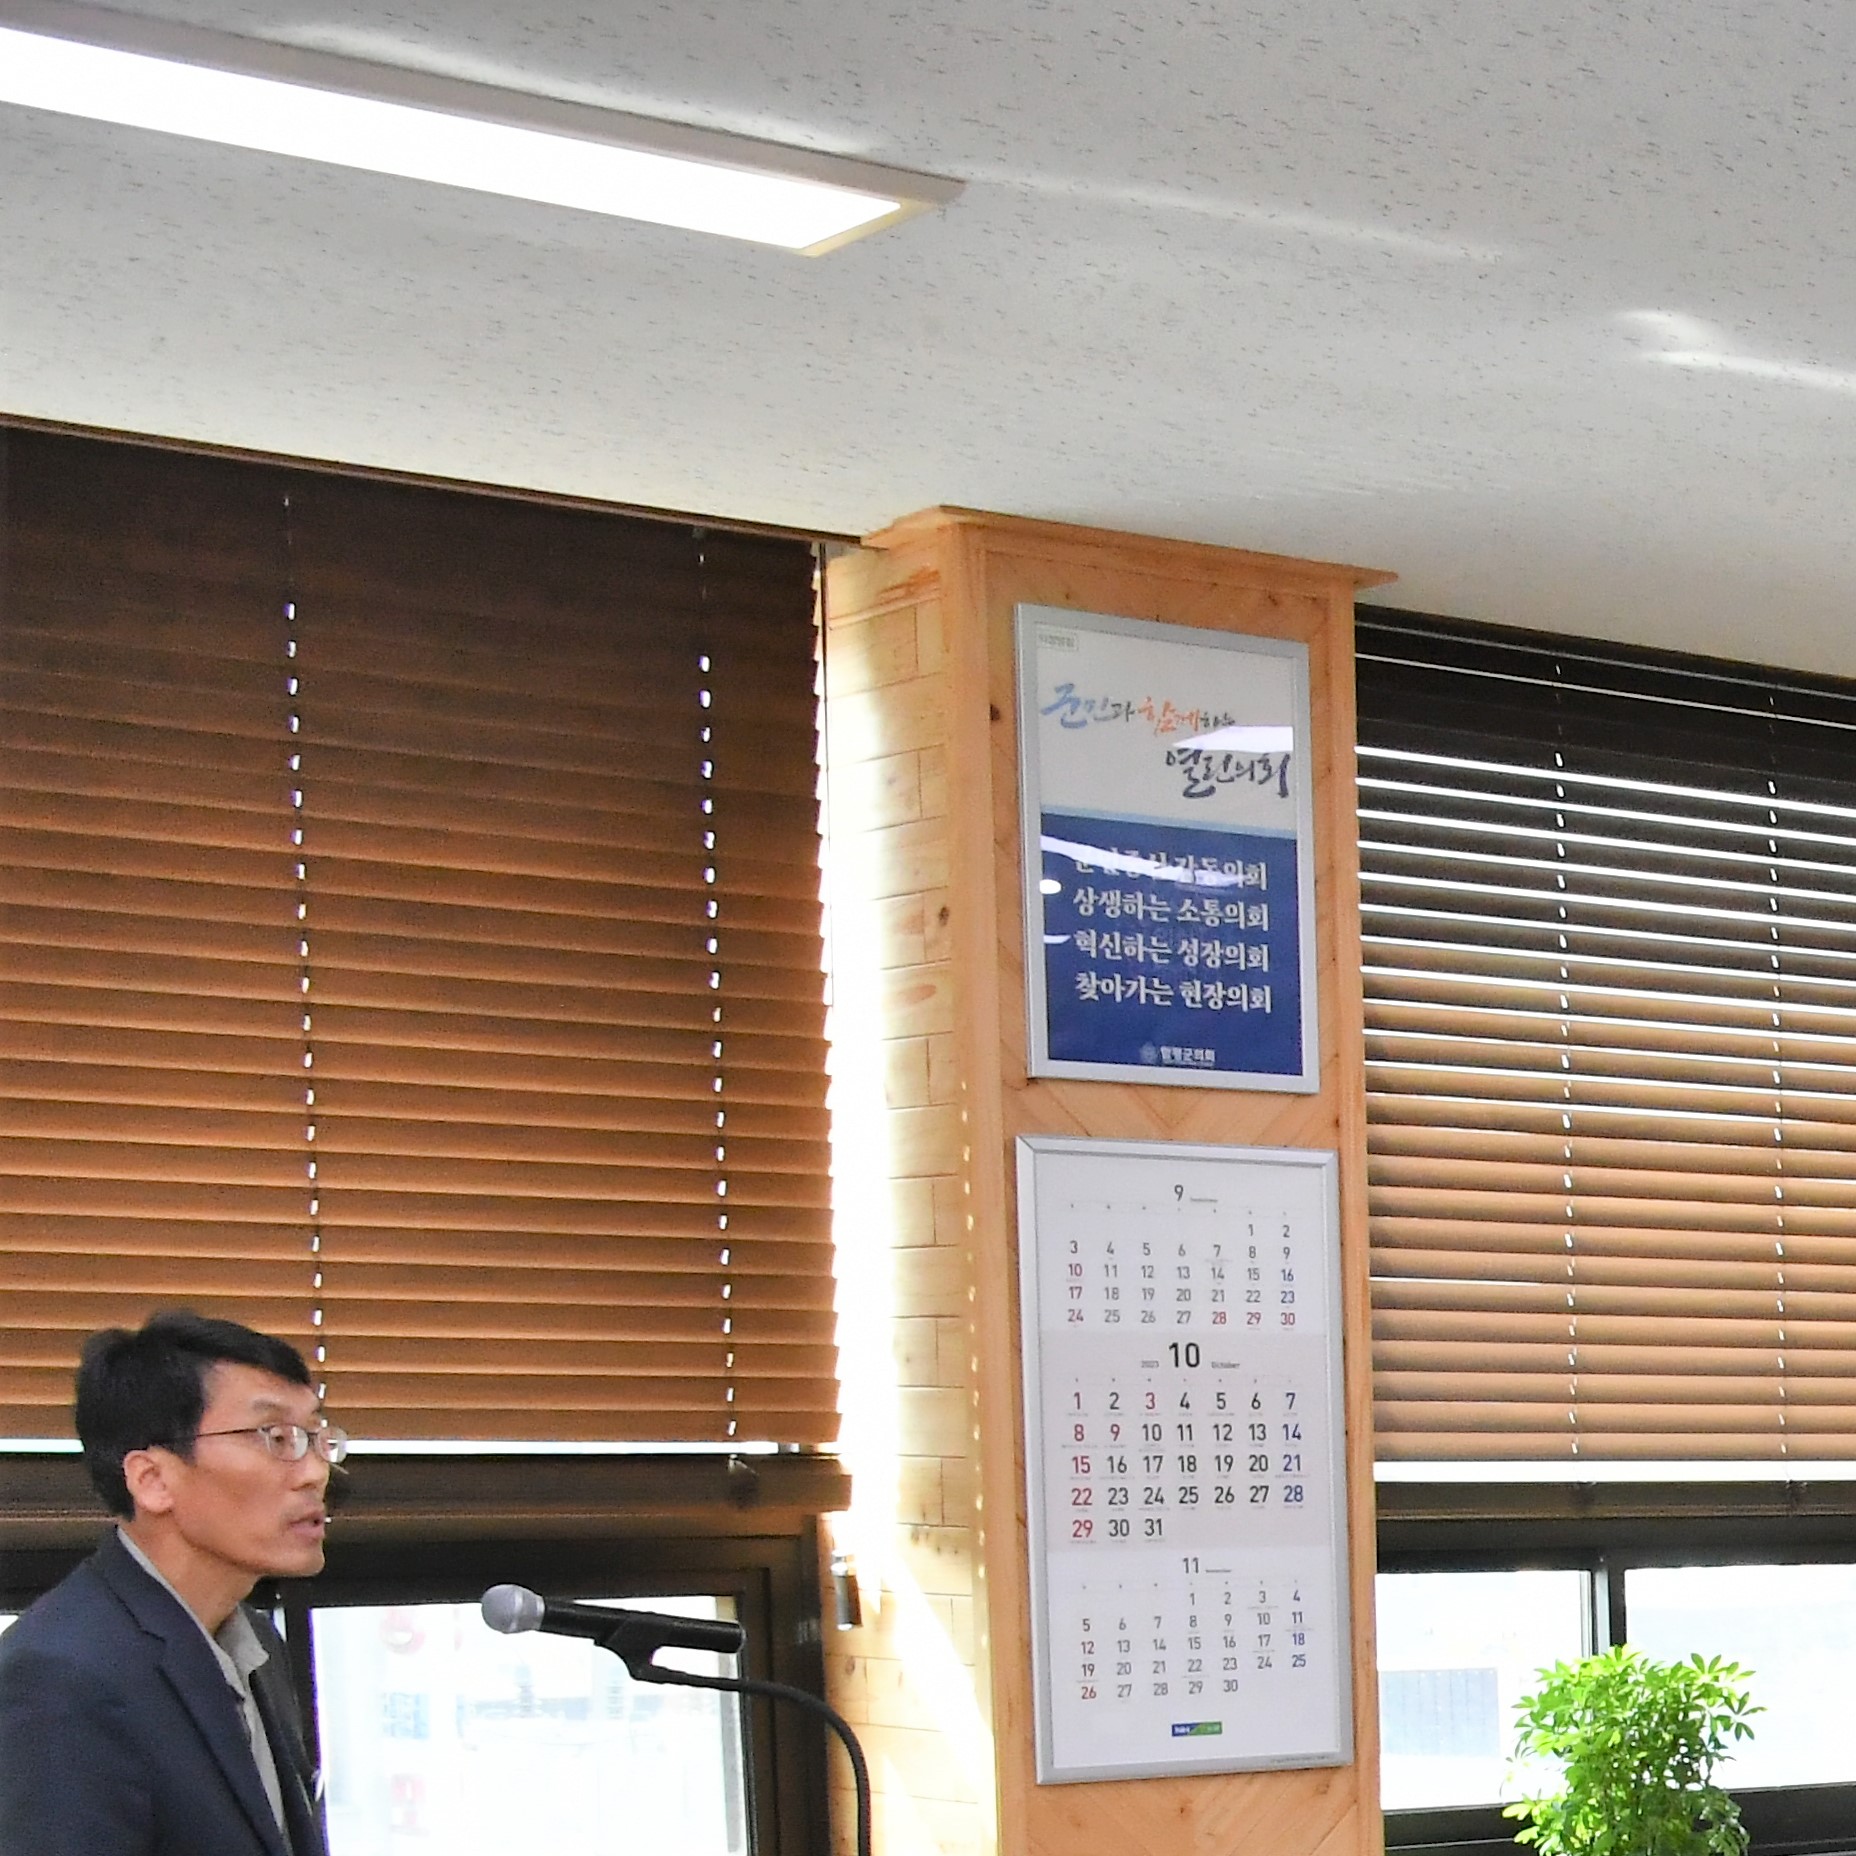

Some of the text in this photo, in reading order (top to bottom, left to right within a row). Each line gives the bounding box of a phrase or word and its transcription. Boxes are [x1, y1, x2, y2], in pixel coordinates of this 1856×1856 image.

[1073, 886, 1269, 932] 상생하는 소통의회
[1073, 929, 1269, 972] 혁신하는 성장의회
[1075, 972, 1272, 1014] 찾아가는 현장의회
[1174, 1184, 1184, 1202] 9
[1247, 1223, 1291, 1239] 1 2
[1069, 1239, 1291, 1260] 3 4 5 6 7 8 9
[1068, 1262, 1295, 1283] 10 11 12 13 14 15 16
[1068, 1285, 1295, 1304] 17 18 19 20 21 22 23
[1067, 1308, 1296, 1326] 24 25 26 27 28 29 30
[1168, 1342, 1200, 1368] 10
[1073, 1391, 1296, 1411] 1 2 3 4 5 6 7
[1073, 1423, 1302, 1442] 8 9 10 11 12 13 14
[1071, 1453, 1301, 1474] 15 16 17 18 19 20 21
[1071, 1484, 1304, 1506] 22 23 24 25 26 27 28
[1072, 1518, 1163, 1538] 29 30 31
[1182, 1556, 1199, 1574] 11
[1189, 1589, 1301, 1606] 1 2 3 4
[1082, 1611, 1303, 1633] 5 6 7 8 9 10 11
[1080, 1632, 1306, 1655] 12 13 14 15 16 17 18
[1081, 1653, 1307, 1677] 19 20 21 22 23 24 25
[1081, 1678, 1239, 1700] 26 27 28 29 30
